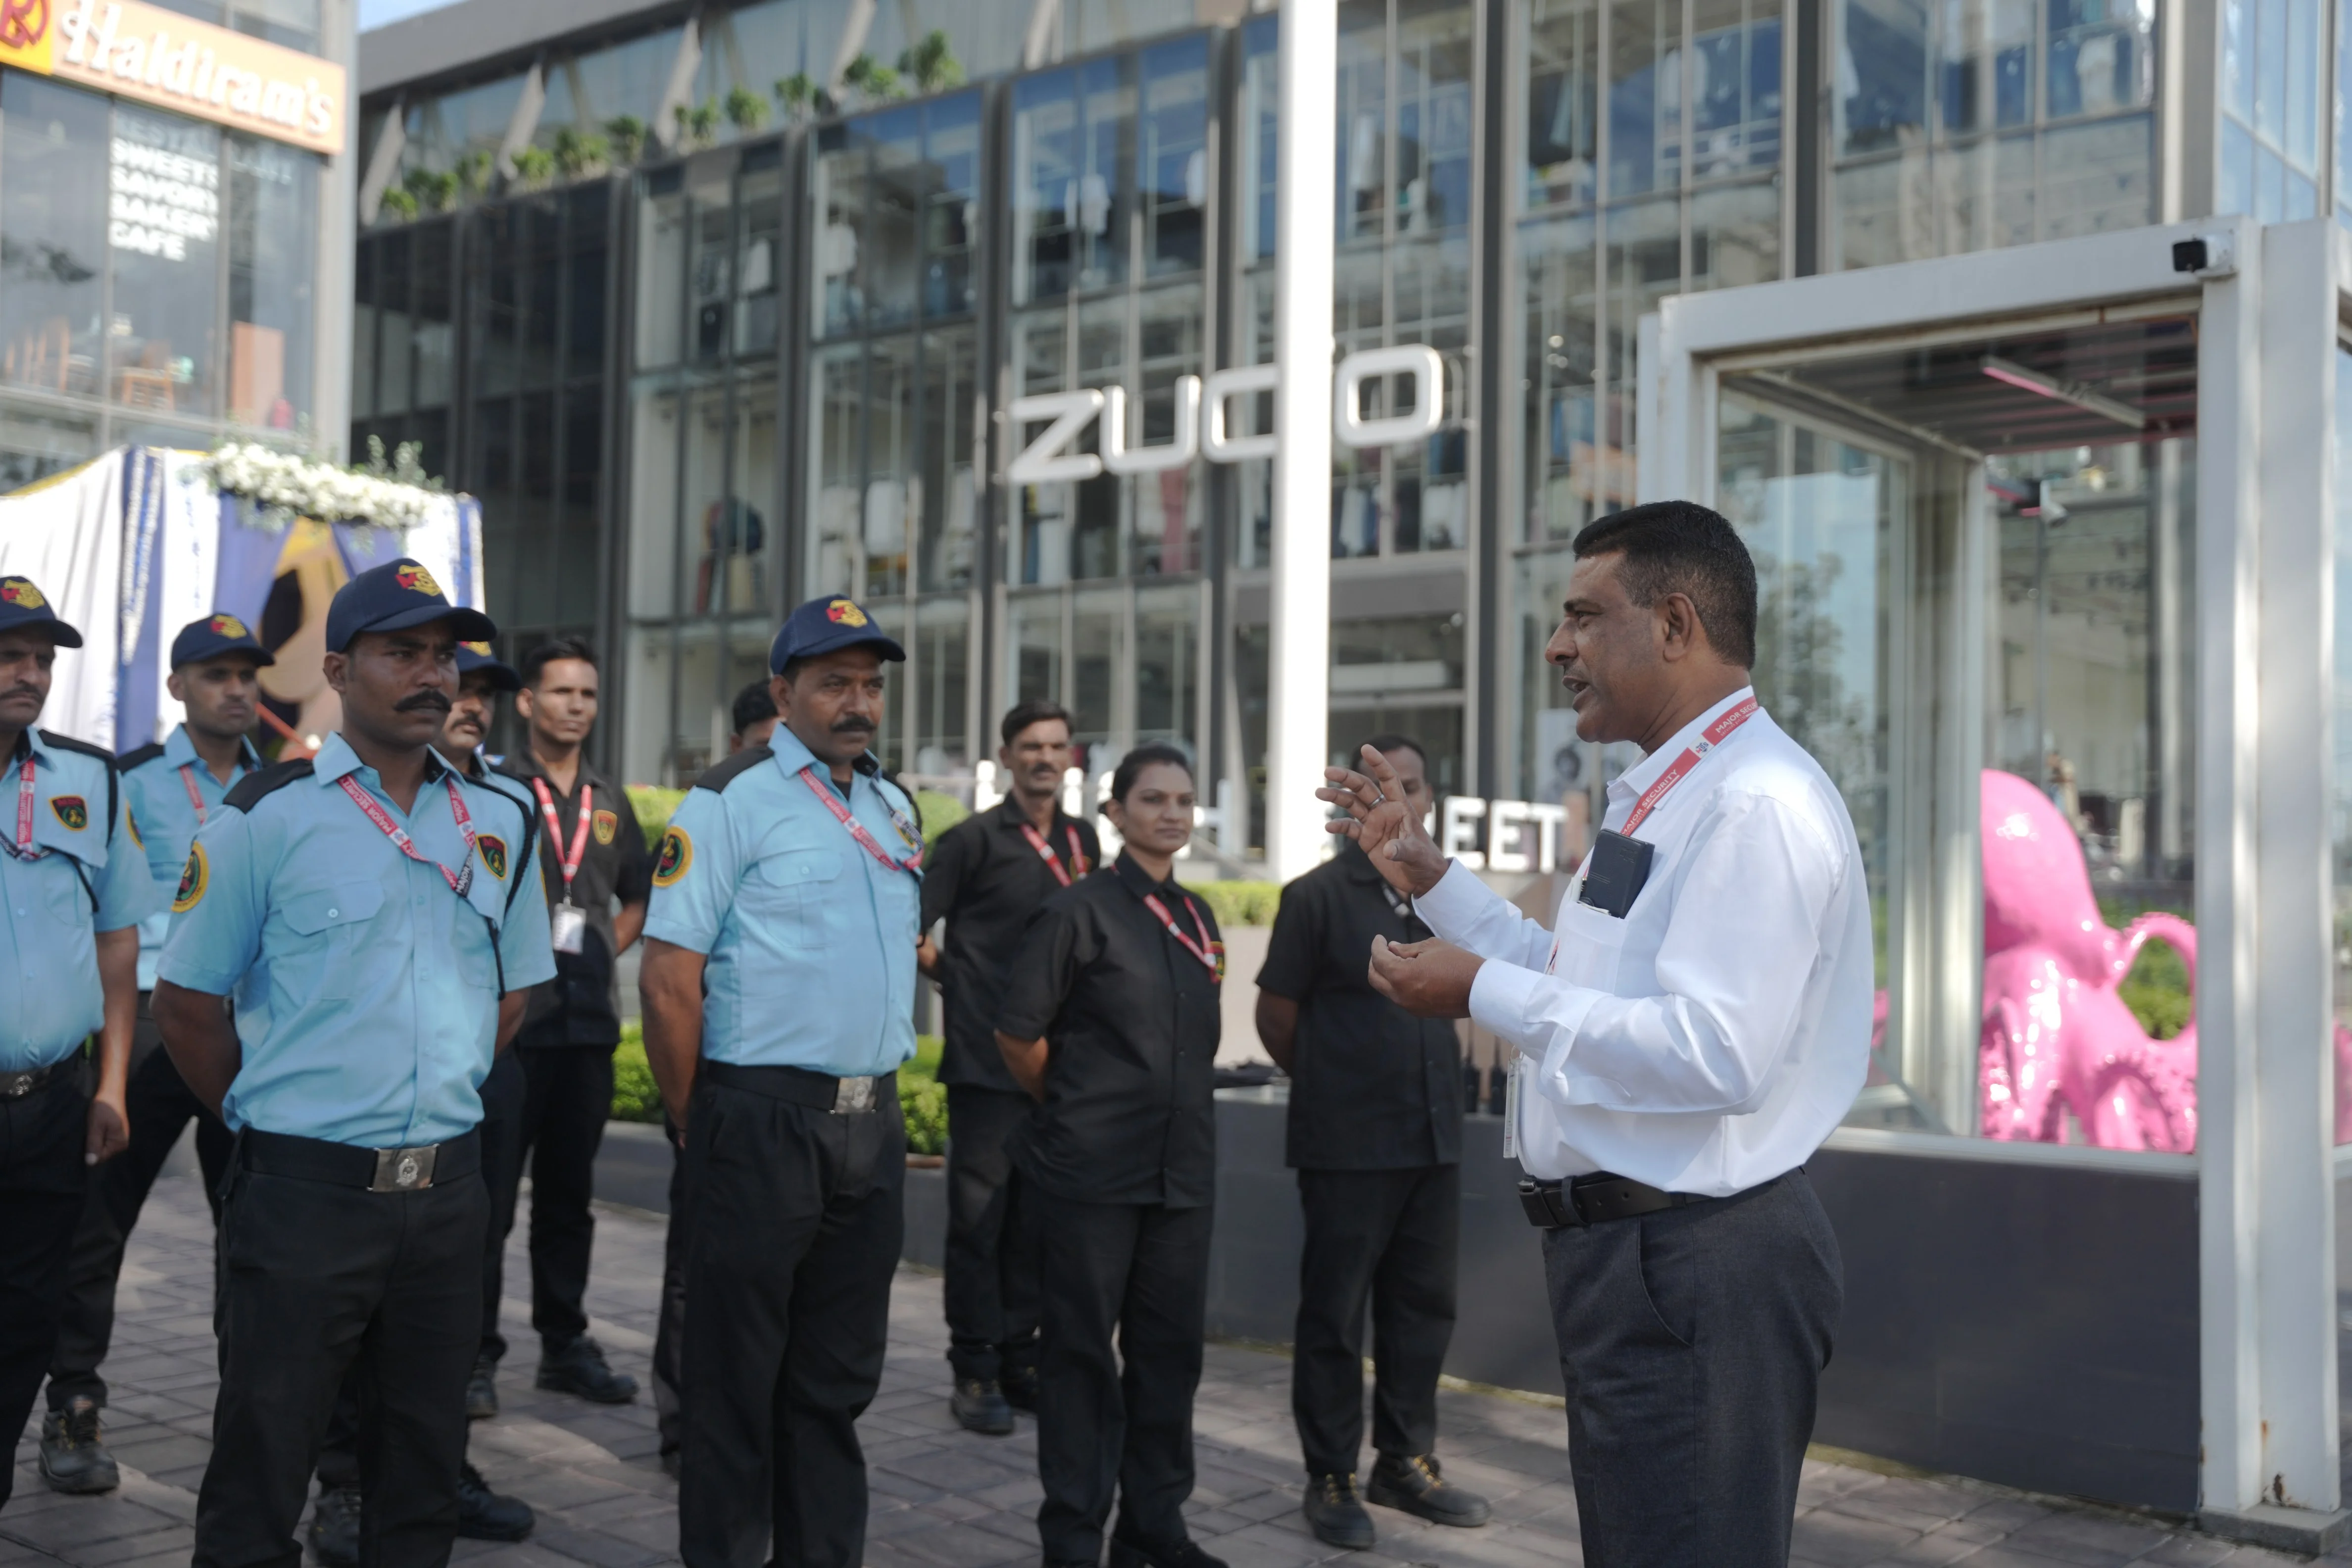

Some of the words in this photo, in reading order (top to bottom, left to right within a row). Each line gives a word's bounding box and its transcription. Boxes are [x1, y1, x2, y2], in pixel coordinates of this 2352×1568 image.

[60, 0, 335, 135] Haldiram's
[1715, 712, 1741, 733] MAJOR
[1695, 742, 1709, 754] MSS
[1642, 769, 1678, 808] SECURITY
[367, 806, 392, 833] MAJOR
[455, 866, 470, 893] MAJOR
